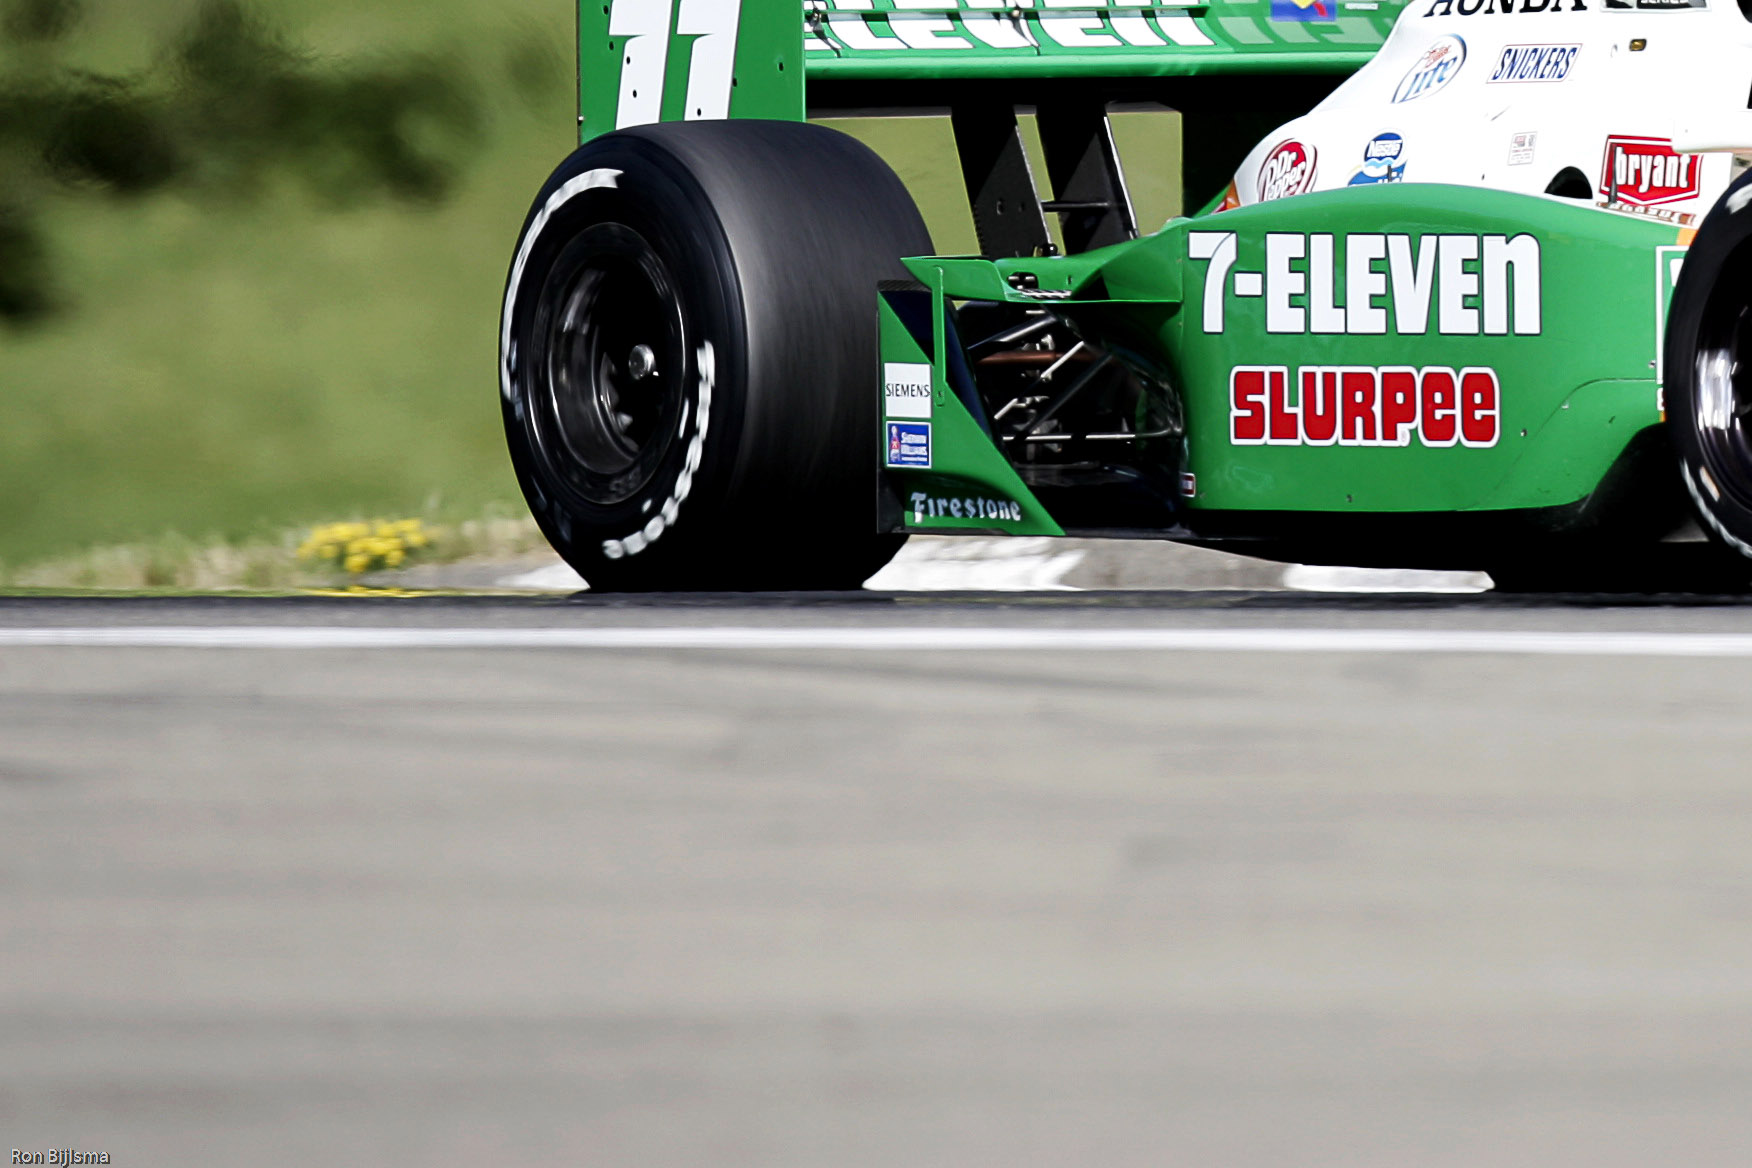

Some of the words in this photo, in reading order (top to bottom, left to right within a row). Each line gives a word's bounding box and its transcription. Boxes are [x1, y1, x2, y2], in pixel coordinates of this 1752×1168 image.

[1491, 47, 1578, 81] SNICKERS
[1614, 146, 1691, 194] bryant
[885, 383, 931, 398] SIEMENS
[910, 491, 1022, 524] Firestone
